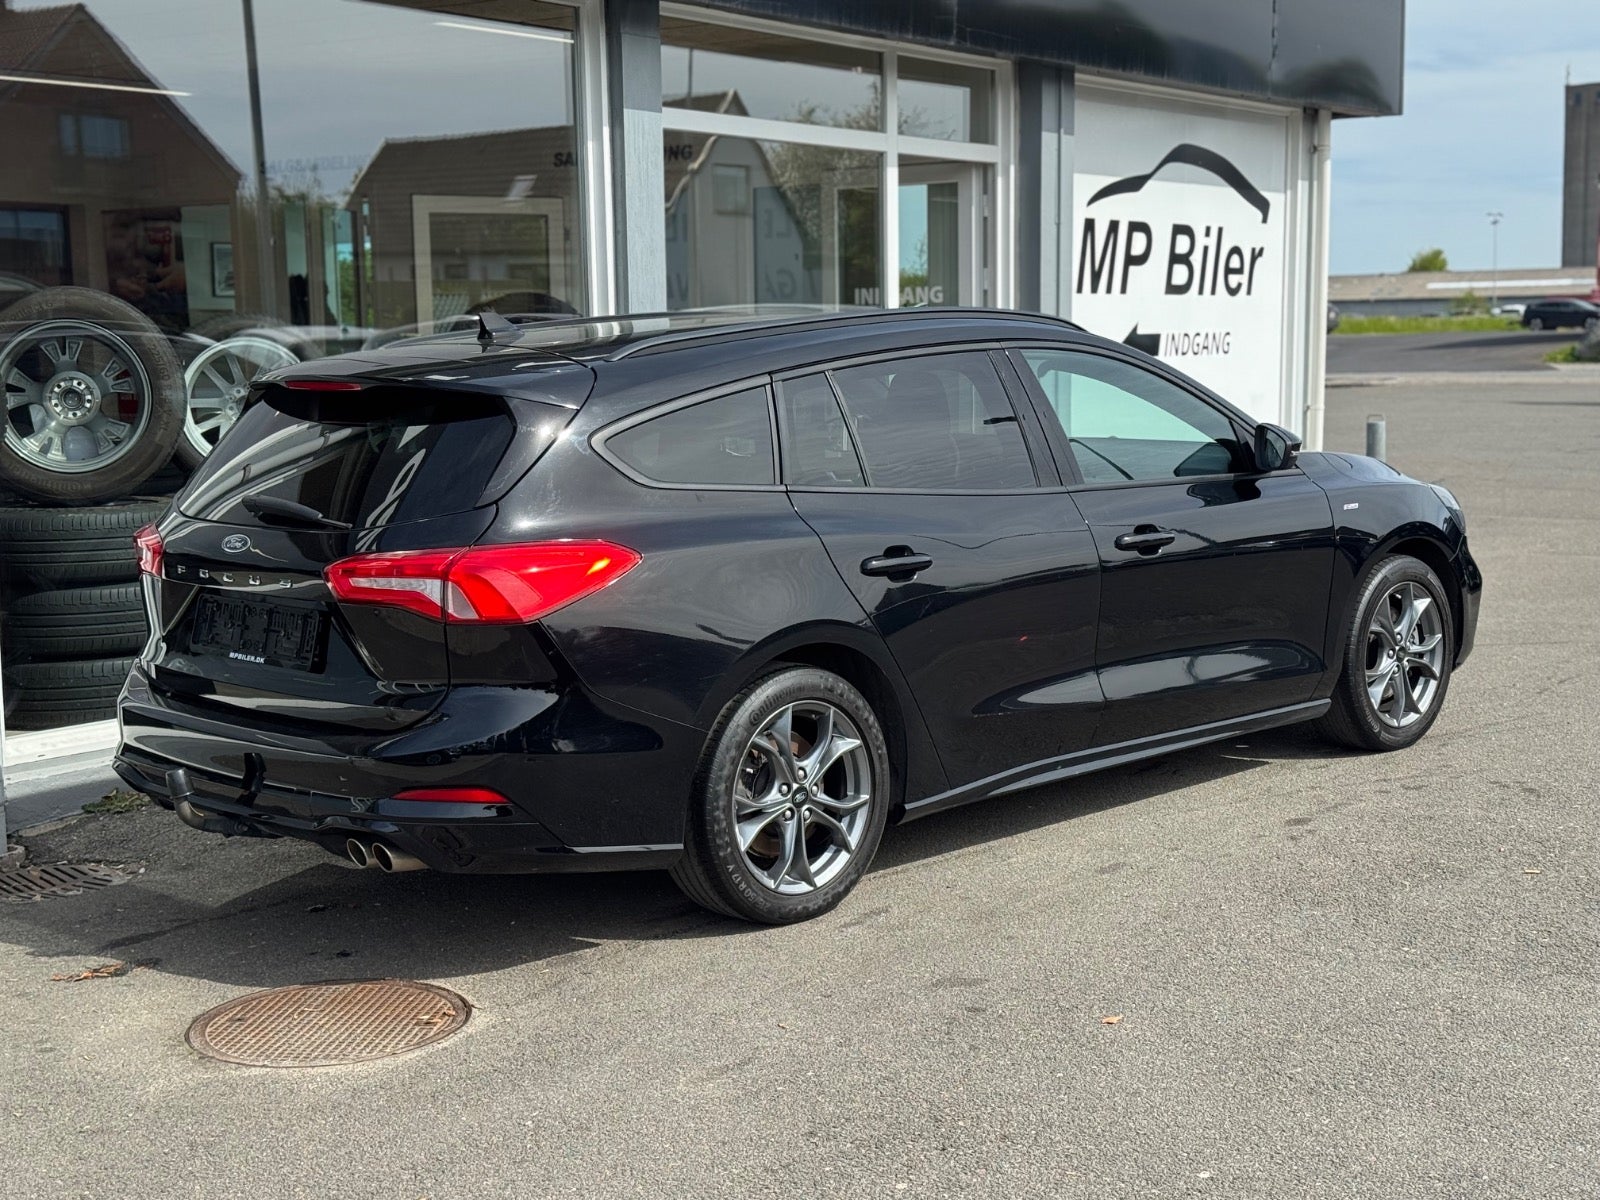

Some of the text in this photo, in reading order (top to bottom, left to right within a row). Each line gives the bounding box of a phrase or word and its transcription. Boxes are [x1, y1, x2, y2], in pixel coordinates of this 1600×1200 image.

[1076, 218, 1265, 297] MP Biler
[1164, 332, 1231, 357] INDGANG
[177, 565, 292, 588] FOCUS
